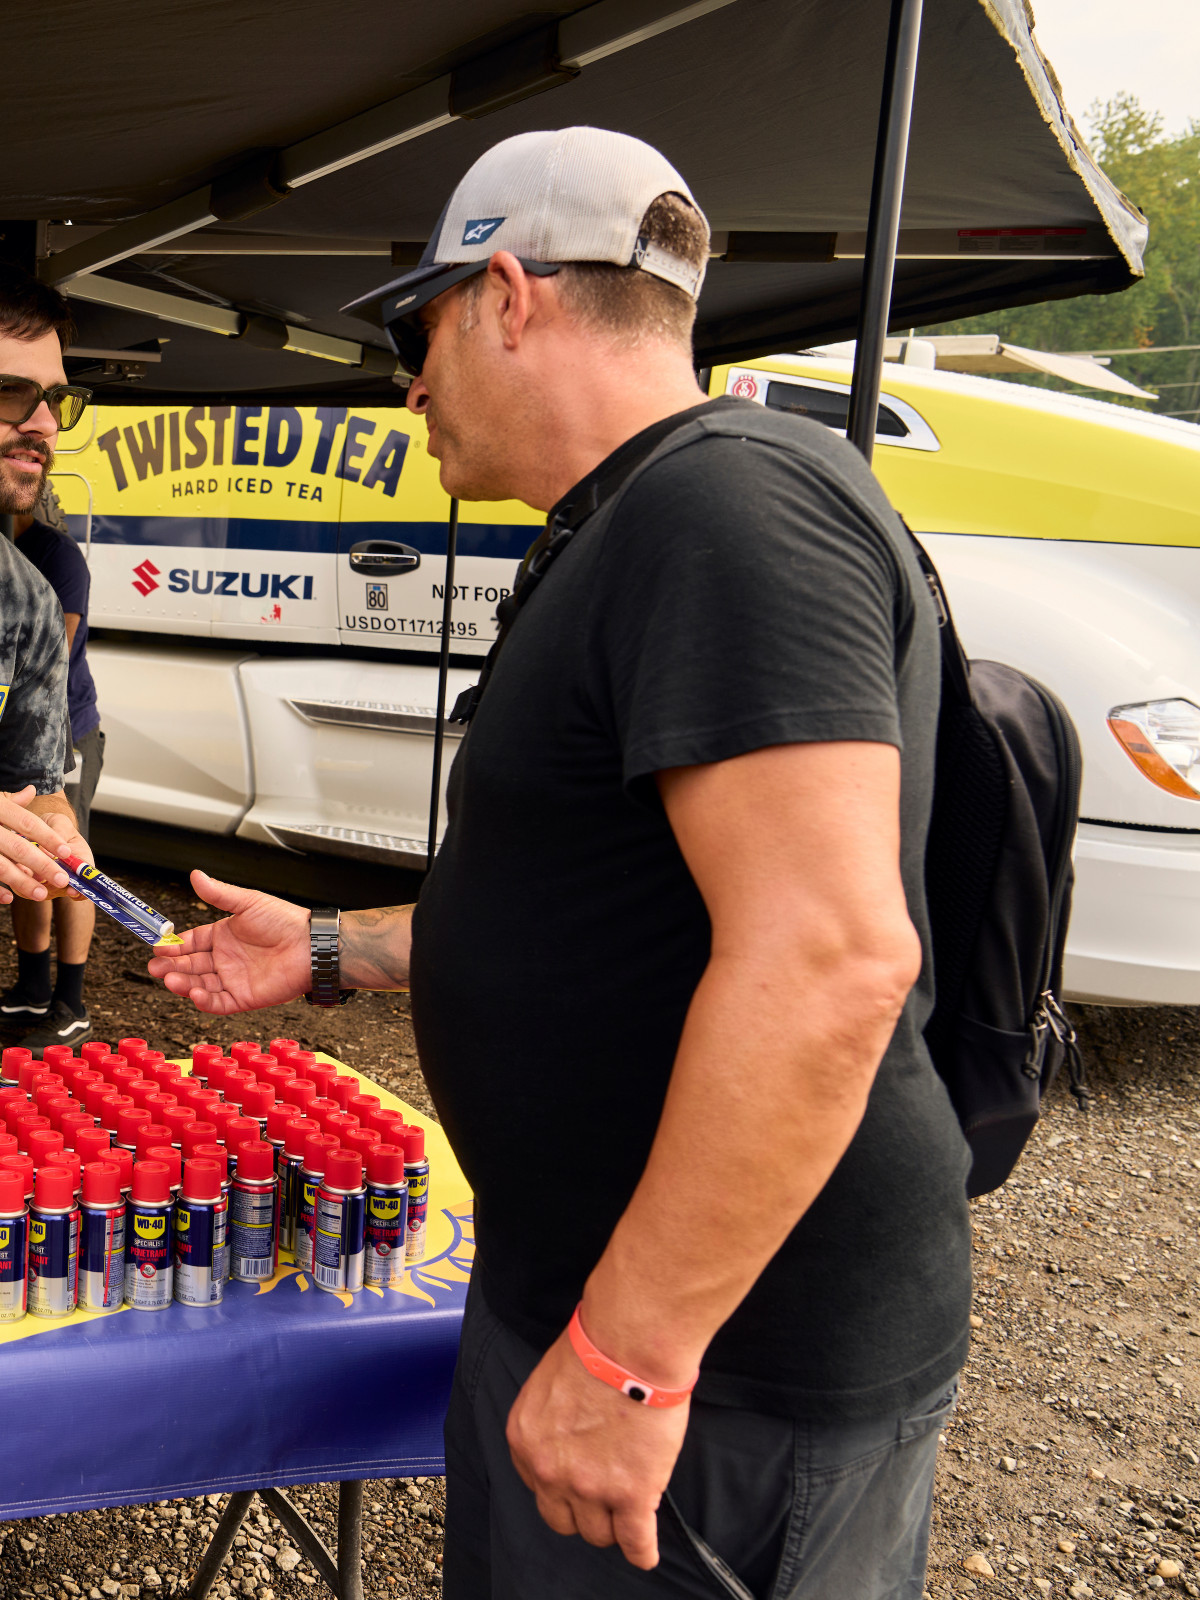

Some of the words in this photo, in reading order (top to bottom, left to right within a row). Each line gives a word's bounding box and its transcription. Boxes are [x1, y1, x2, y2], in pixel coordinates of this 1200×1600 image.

[98, 406, 304, 492] TWISTED
[310, 407, 411, 498] TEA
[172, 478, 219, 498] HARD
[227, 477, 273, 494] ICED
[286, 482, 323, 502] TEA
[167, 568, 314, 600] SUZUKI
[369, 590, 386, 608] 80
[474, 587, 511, 602] FOR
[345, 615, 478, 637] USDOT1712495
[373, 1199, 398, 1210] WD-40
[137, 1217, 163, 1230] WD-40
[369, 1219, 400, 1227] SPECIALIST
[365, 1227, 401, 1237] PENETRANT
[134, 1238, 164, 1247] SPECIALIST
[130, 1246, 167, 1258] PENETRANT
